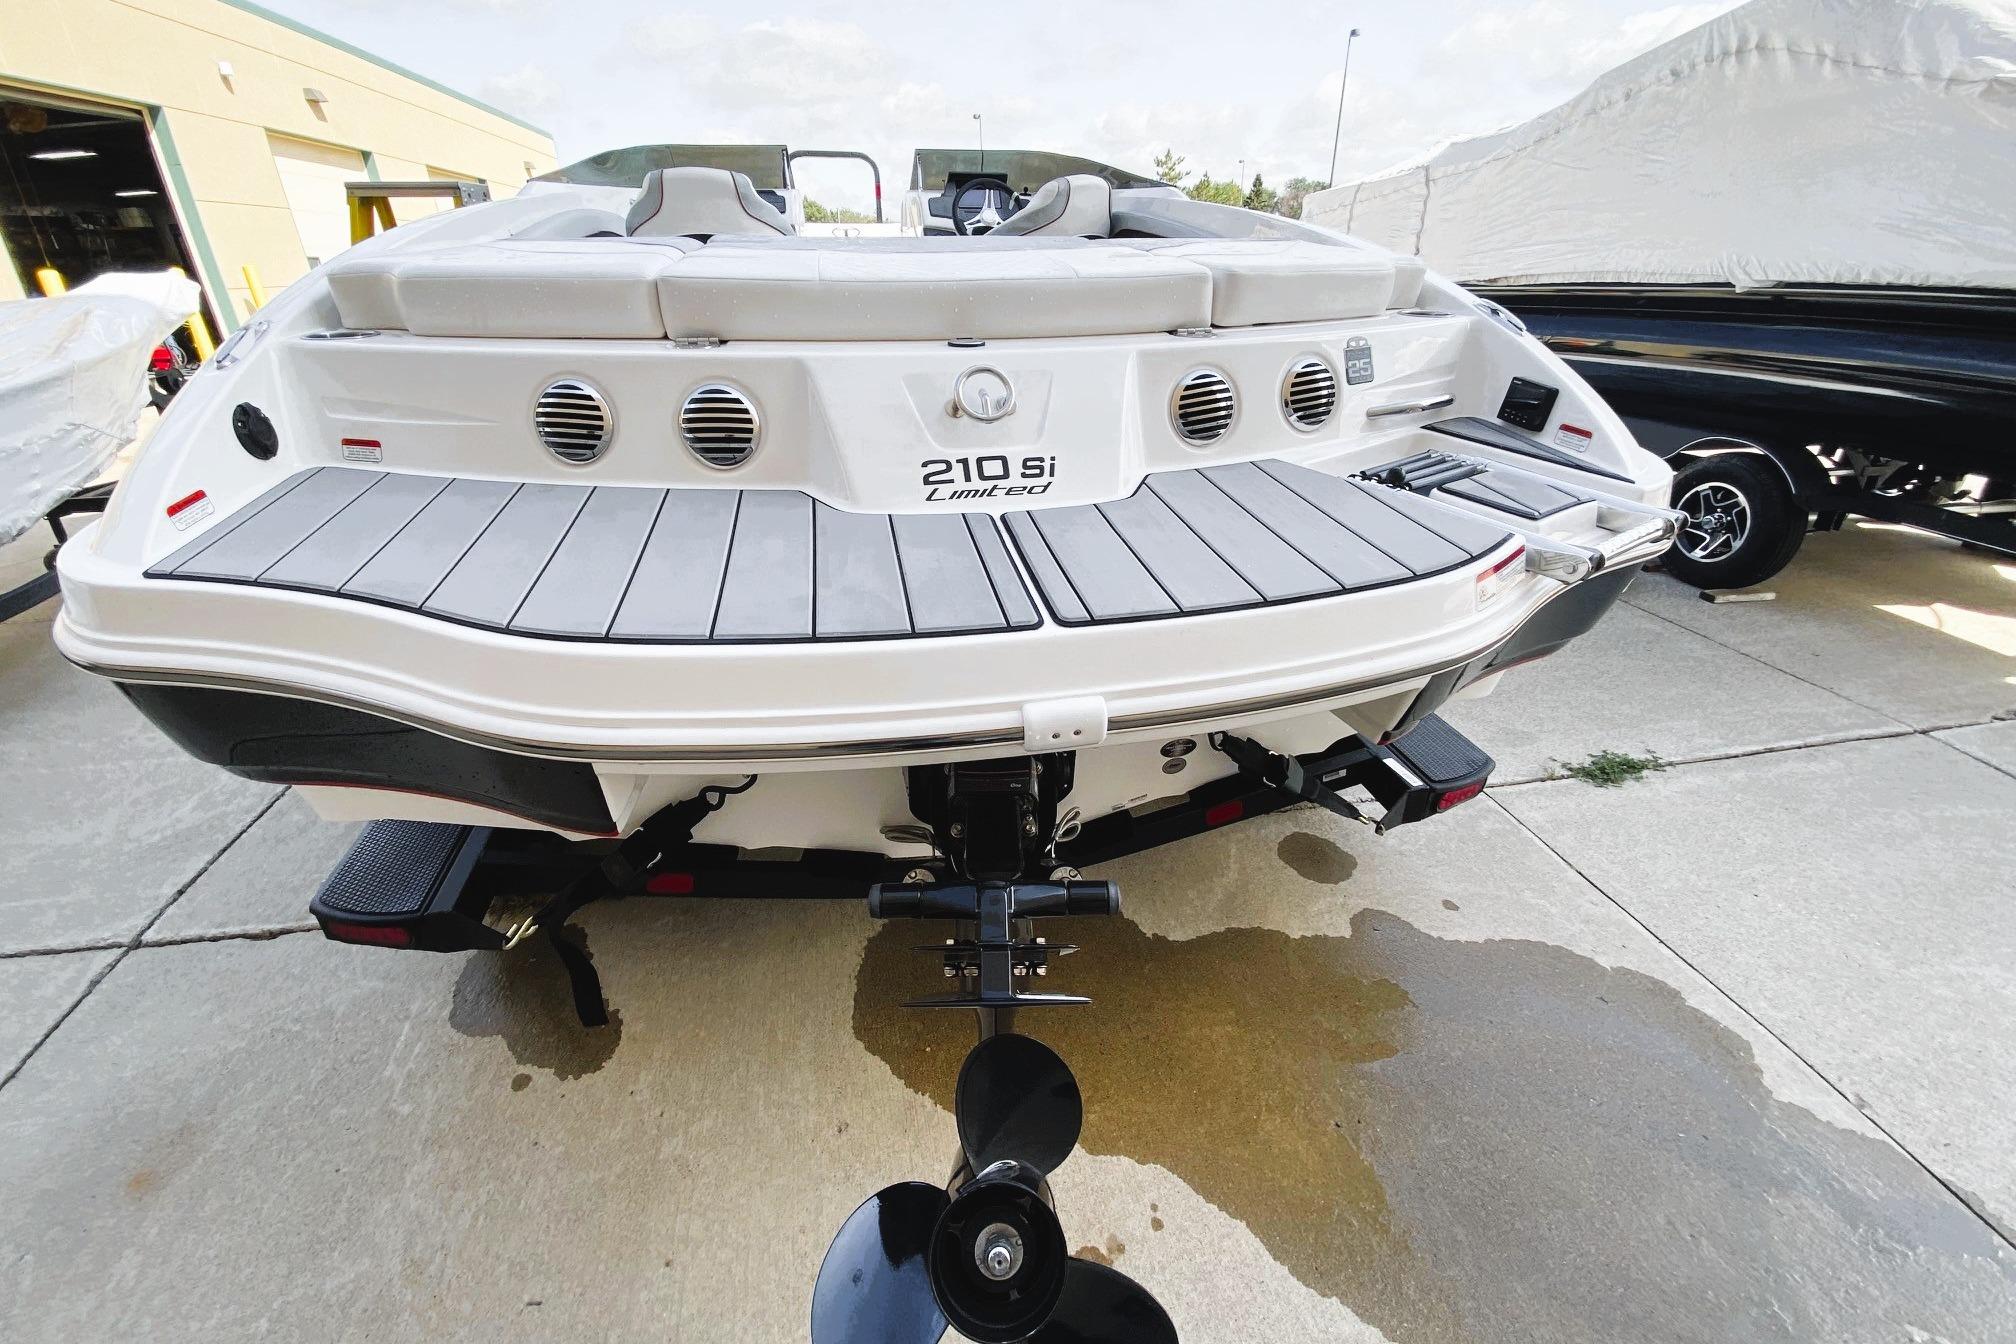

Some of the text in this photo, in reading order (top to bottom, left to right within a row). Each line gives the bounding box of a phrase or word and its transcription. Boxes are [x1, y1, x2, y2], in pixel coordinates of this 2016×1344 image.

[1348, 358, 1372, 378] 25
[921, 455, 1010, 486] 210
[925, 482, 1053, 502] Limited
